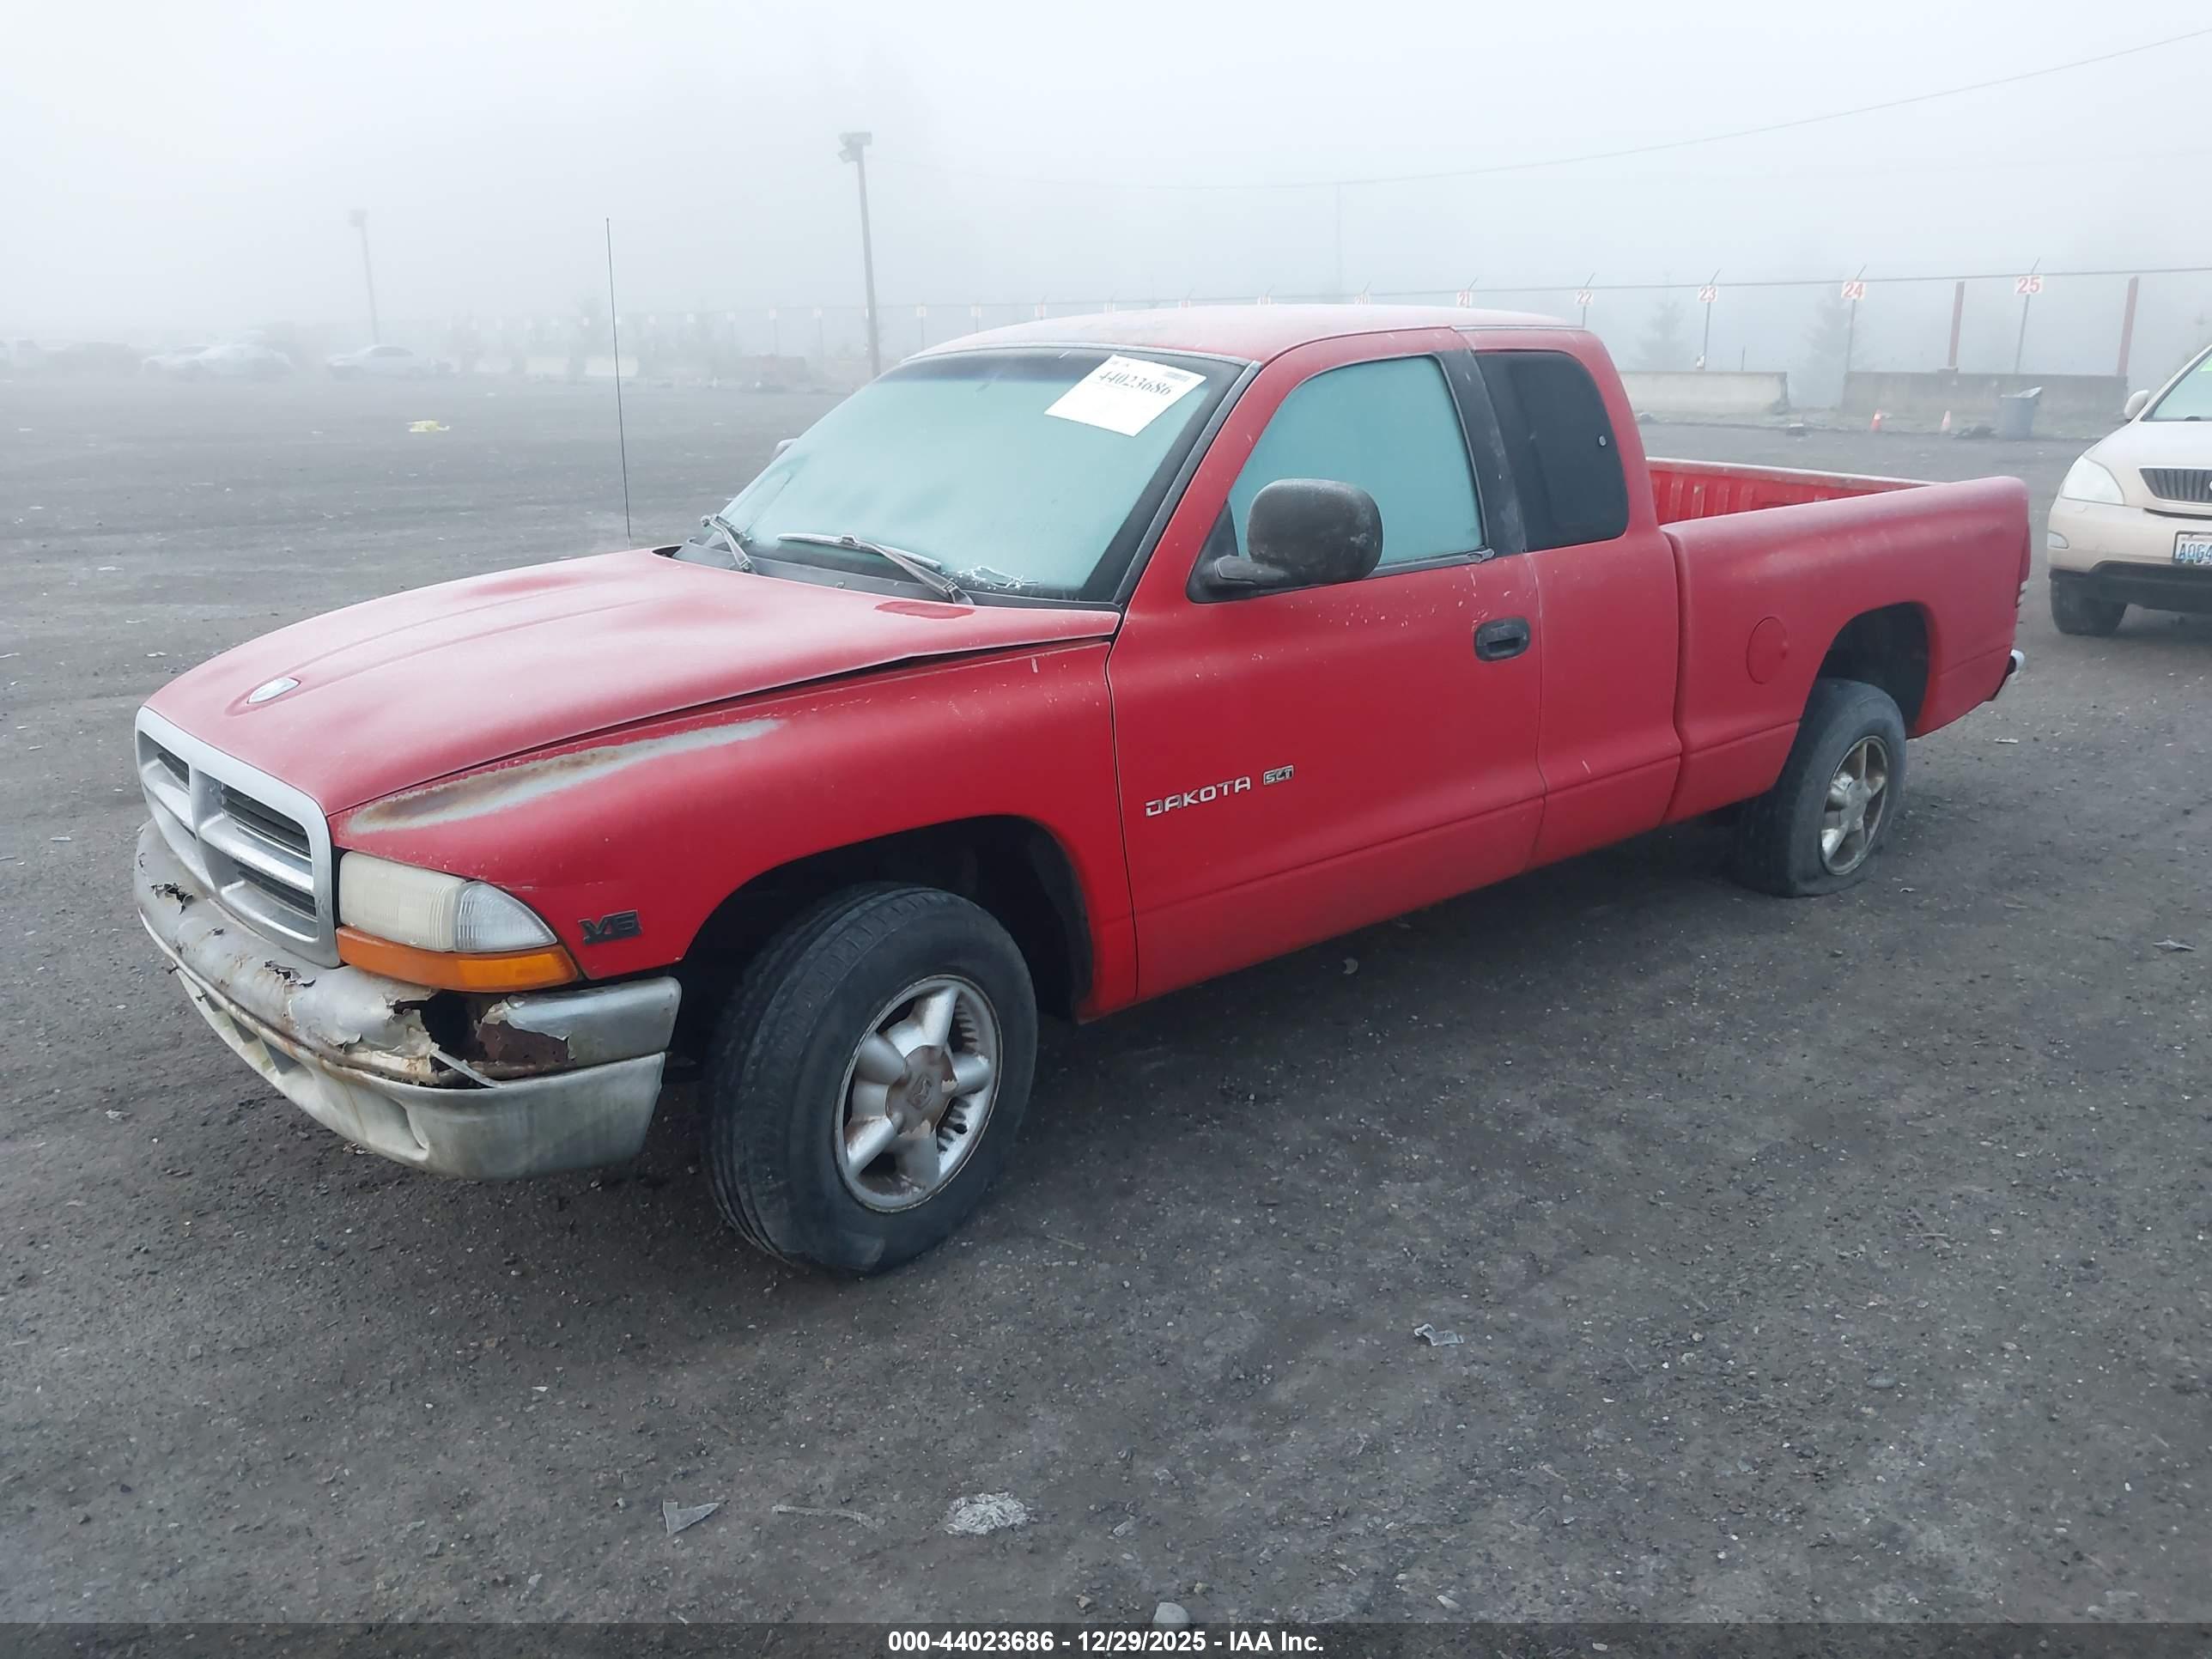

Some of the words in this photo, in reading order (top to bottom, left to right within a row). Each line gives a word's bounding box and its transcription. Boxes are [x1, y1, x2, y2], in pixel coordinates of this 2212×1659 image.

[1844, 282, 1864, 298] 24
[2017, 275, 2040, 294] 25
[1458, 291, 1470, 306] 21
[1577, 289, 1592, 304] 22
[1699, 286, 1717, 301] 23
[1098, 370, 1172, 396] 44023686
[1145, 775, 1251, 817] DAKOTA
[1264, 766, 1294, 785] SLT
